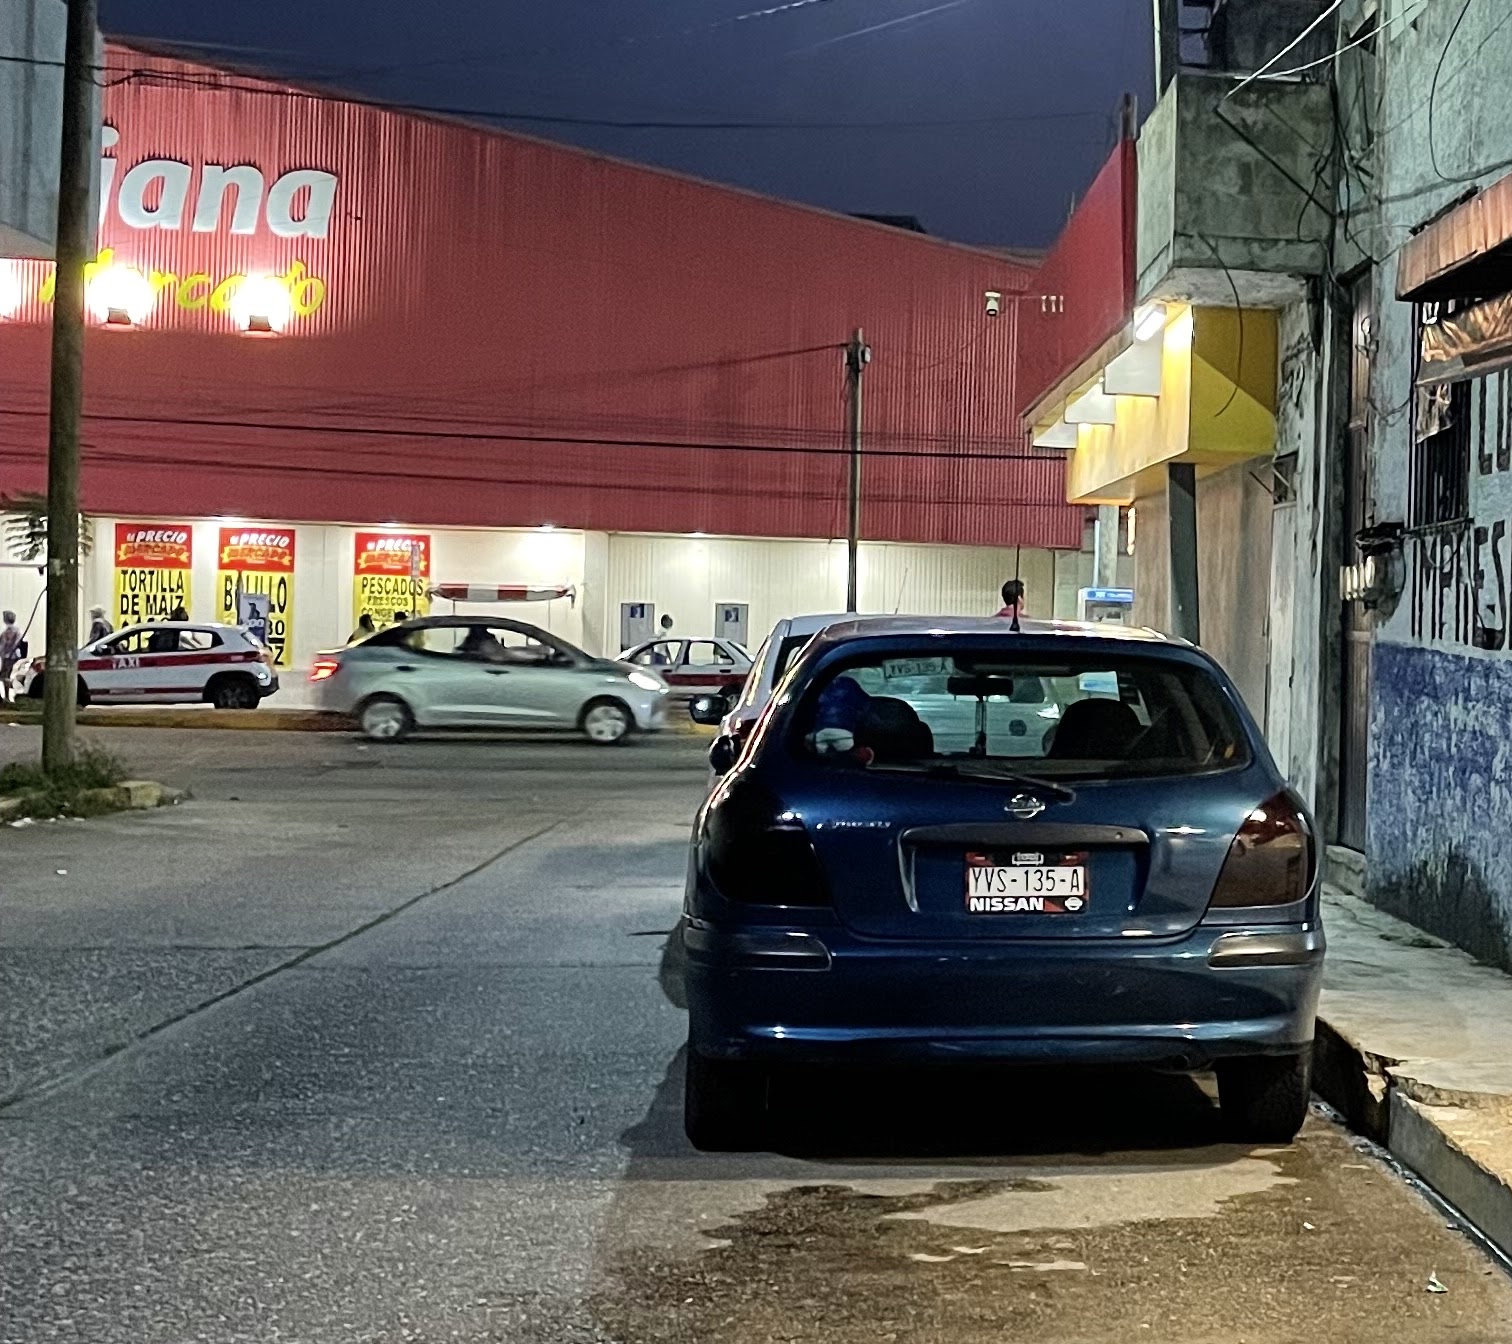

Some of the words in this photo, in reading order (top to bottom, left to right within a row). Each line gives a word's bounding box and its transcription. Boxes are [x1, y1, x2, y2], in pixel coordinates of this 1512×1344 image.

[135, 530, 187, 544] PRECIO
[238, 533, 290, 548] PRECIO
[120, 568, 185, 594] TORTILLA
[361, 576, 424, 597] PESCADOS
[120, 594, 140, 616] DE
[367, 595, 409, 607] FRESCOS
[111, 657, 140, 670] TAXI
[972, 867, 1081, 894] YVS-135-A
[969, 896, 1045, 913] NISSAN
